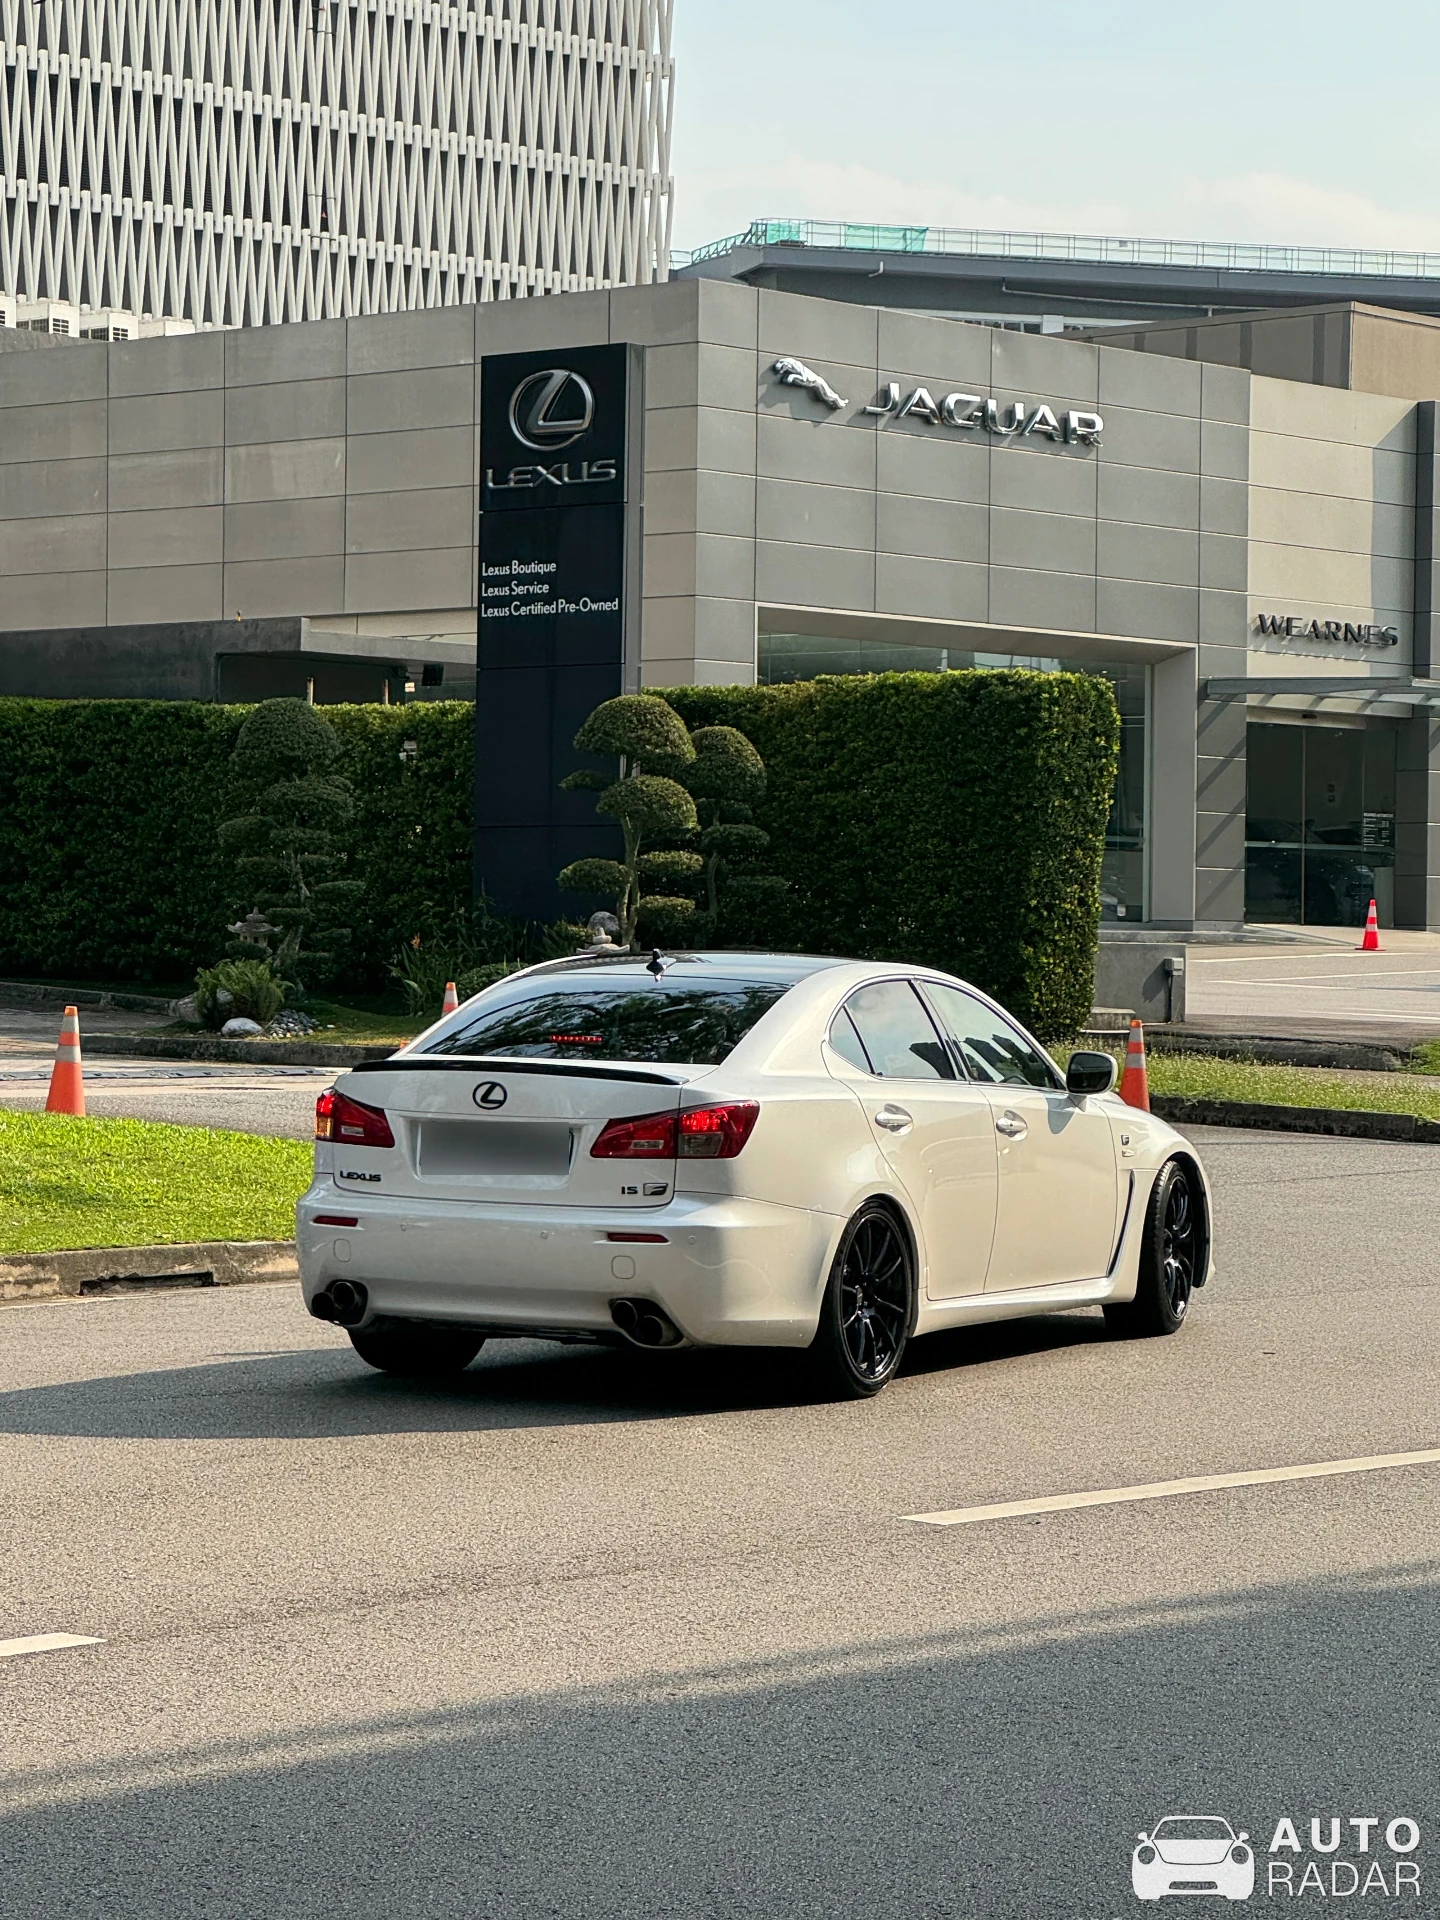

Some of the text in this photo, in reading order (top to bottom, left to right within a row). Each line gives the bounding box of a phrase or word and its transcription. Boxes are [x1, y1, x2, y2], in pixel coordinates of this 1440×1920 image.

[861, 382, 1104, 447] JAGUAR
[486, 459, 617, 490] LEXUS
[481, 560, 557, 577] Lexus Boutique
[481, 580, 550, 597] Lexus Service
[481, 597, 619, 618] Lexus Certified Pre-Owned
[1258, 613, 1399, 646] WEARNES
[340, 1170, 381, 1182] LEXUS
[621, 1186, 638, 1195] IS
